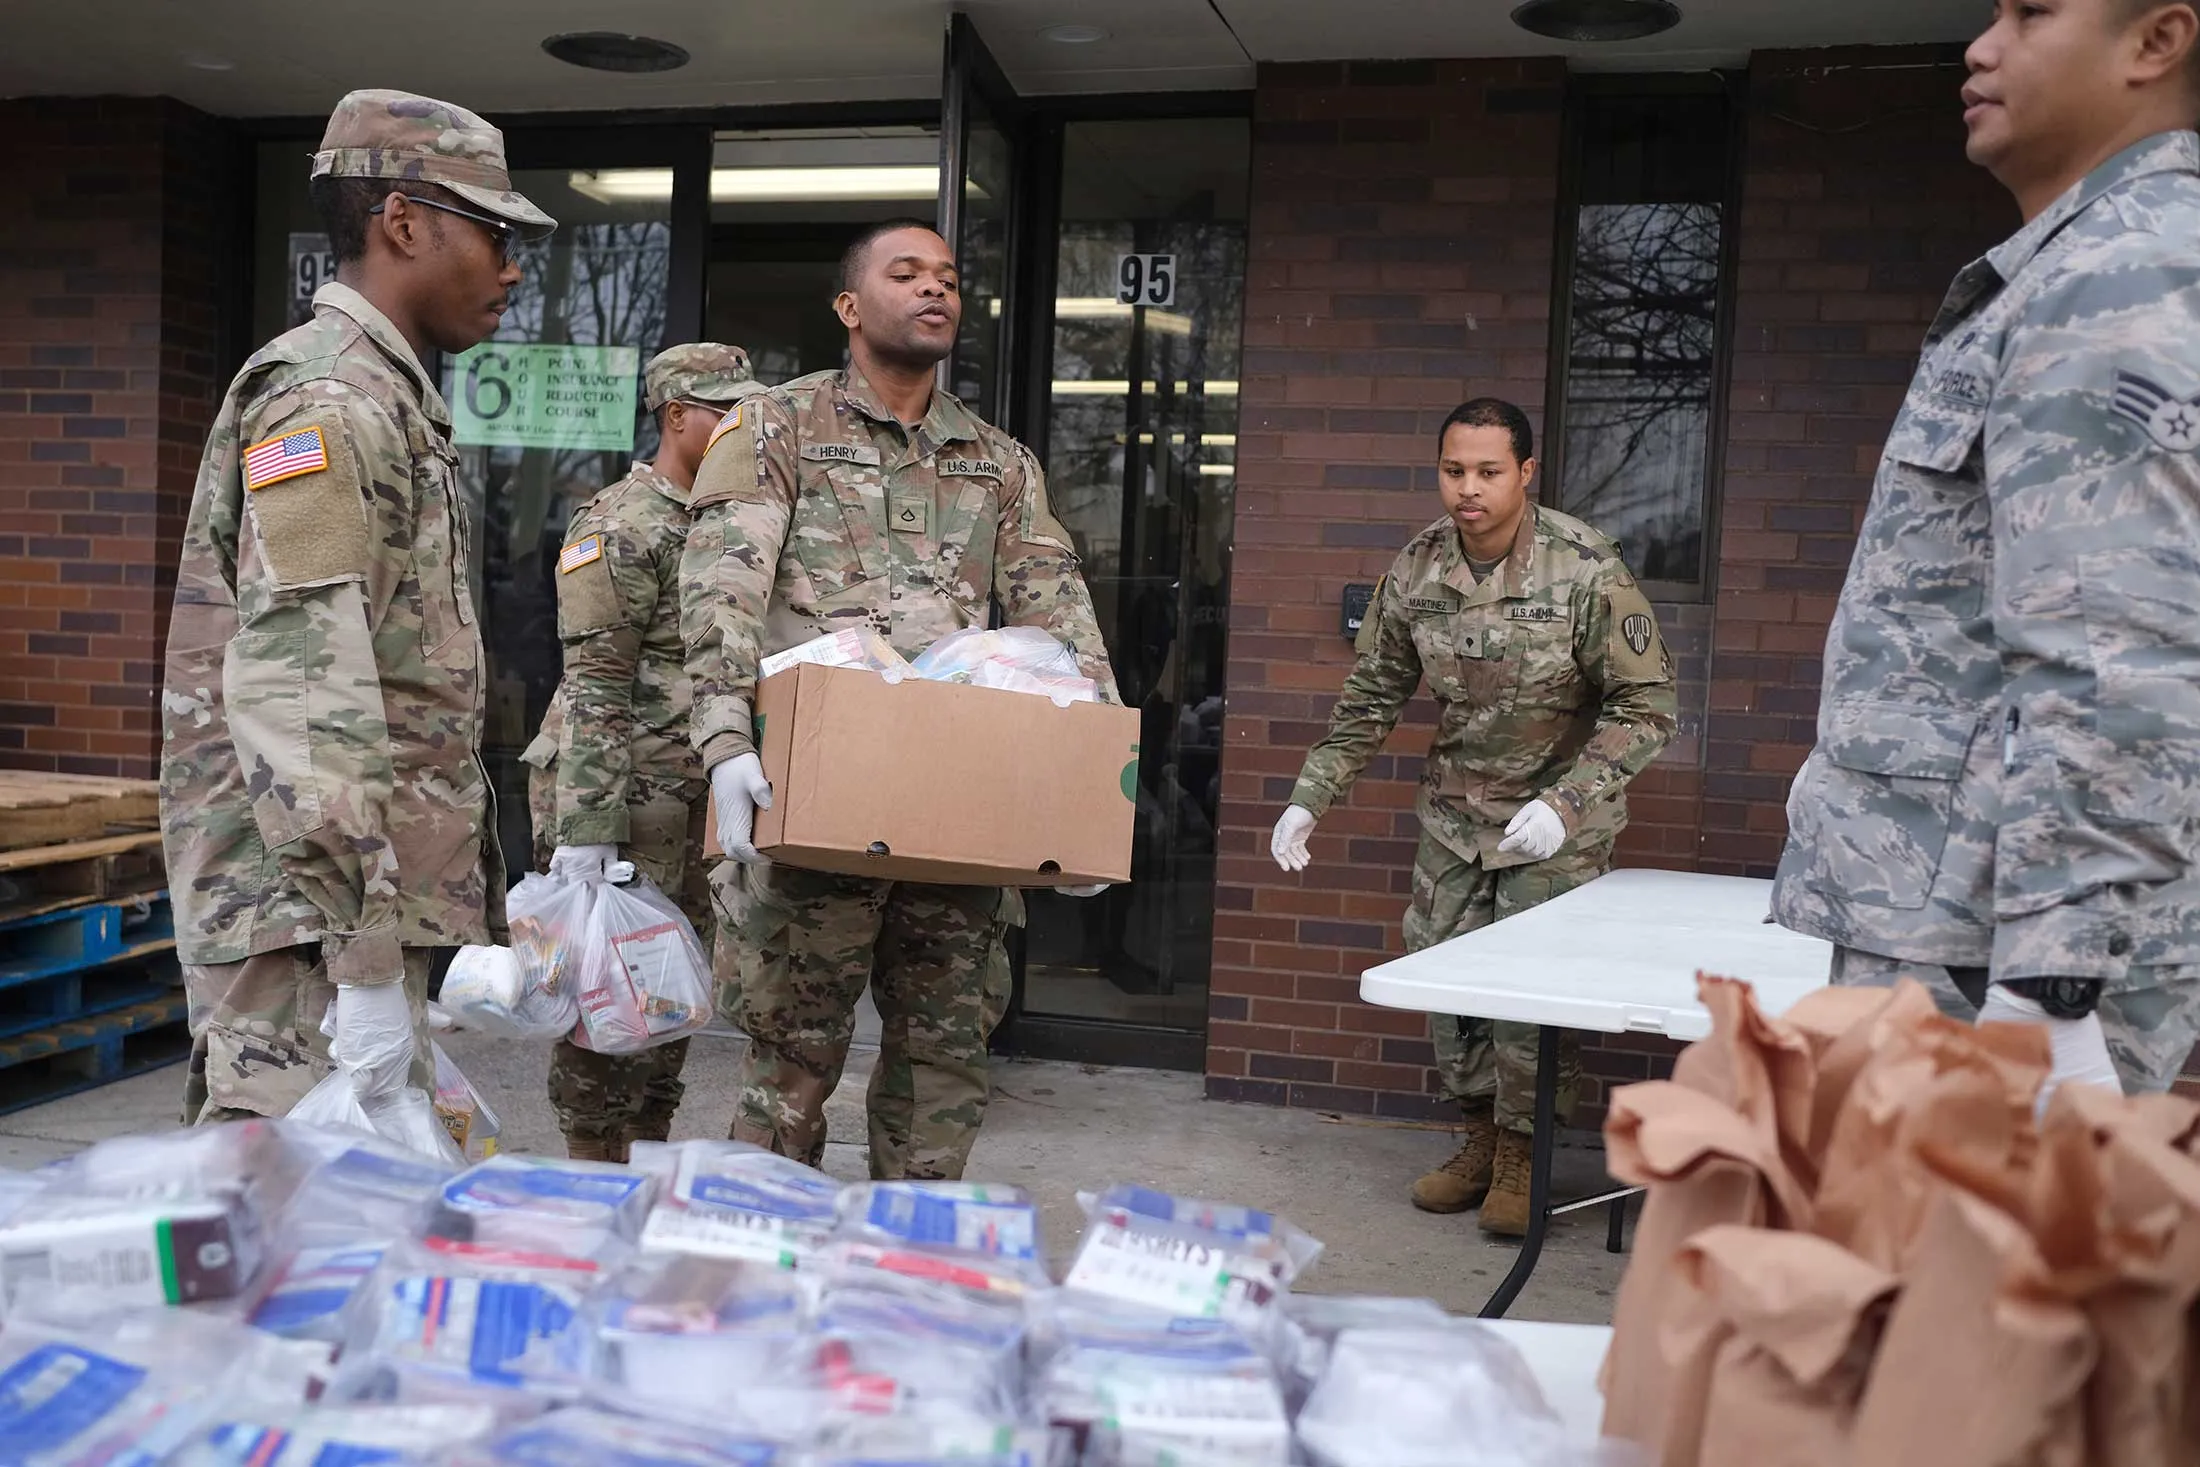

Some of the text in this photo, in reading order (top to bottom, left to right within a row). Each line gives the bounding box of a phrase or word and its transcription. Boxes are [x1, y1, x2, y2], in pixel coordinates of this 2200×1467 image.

[1120, 255, 1171, 304] 95
[465, 352, 512, 420] 6
[547, 375, 620, 386] INSURANCE
[545, 390, 624, 403] REDUCTION
[546, 407, 599, 418] COURSE
[820, 446, 858, 460] HENRY
[947, 461, 1003, 478] U.S. ARMY
[1409, 597, 1447, 611] MARTINEZ
[1512, 607, 1553, 620] U.S. ARMY
